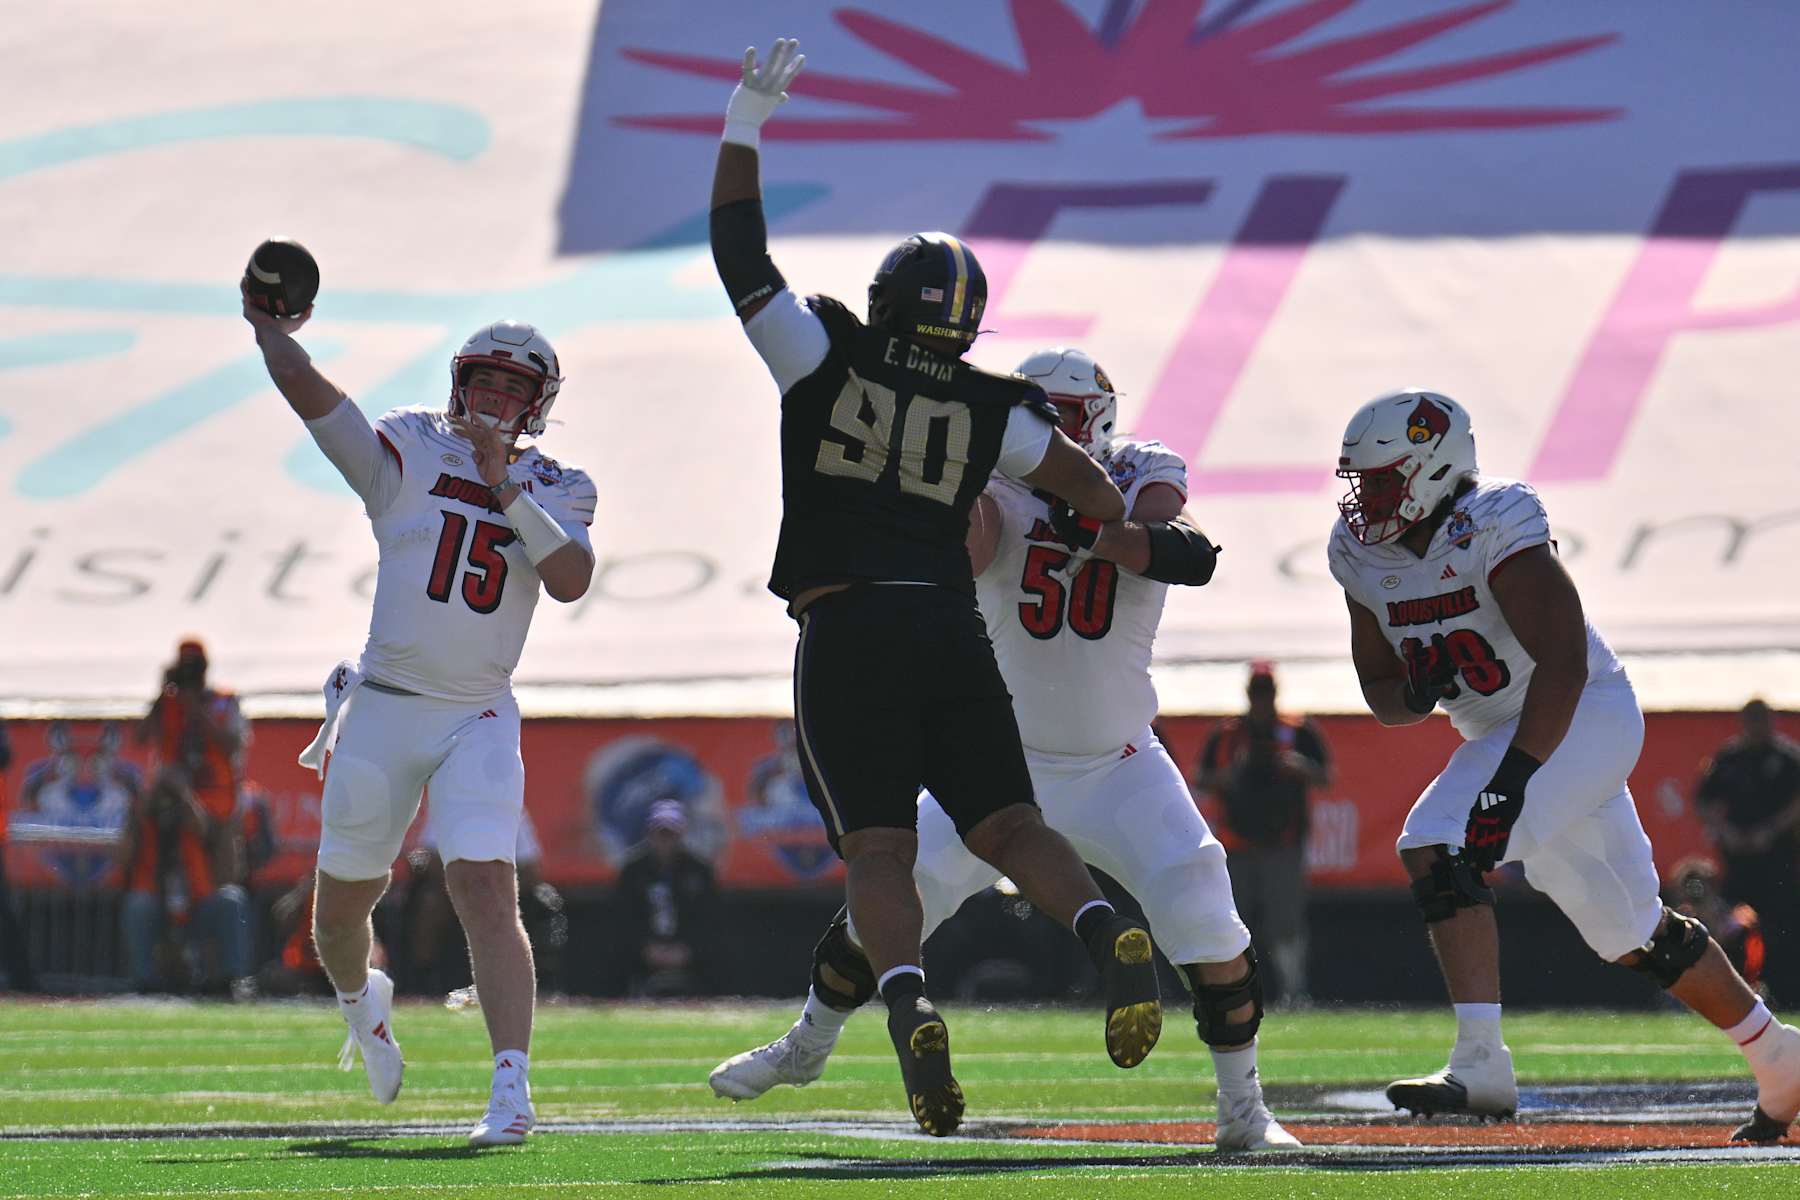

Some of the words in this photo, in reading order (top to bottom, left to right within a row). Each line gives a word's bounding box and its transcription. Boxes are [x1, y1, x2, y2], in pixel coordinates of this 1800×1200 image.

[884, 337, 899, 366] E.
[916, 323, 977, 343] WASHIN
[815, 372, 972, 505] 90
[428, 472, 506, 516] LOUIS
[426, 509, 518, 614] 15
[1018, 544, 1119, 640] 50
[1386, 585, 1480, 627] LOUISVILLE
